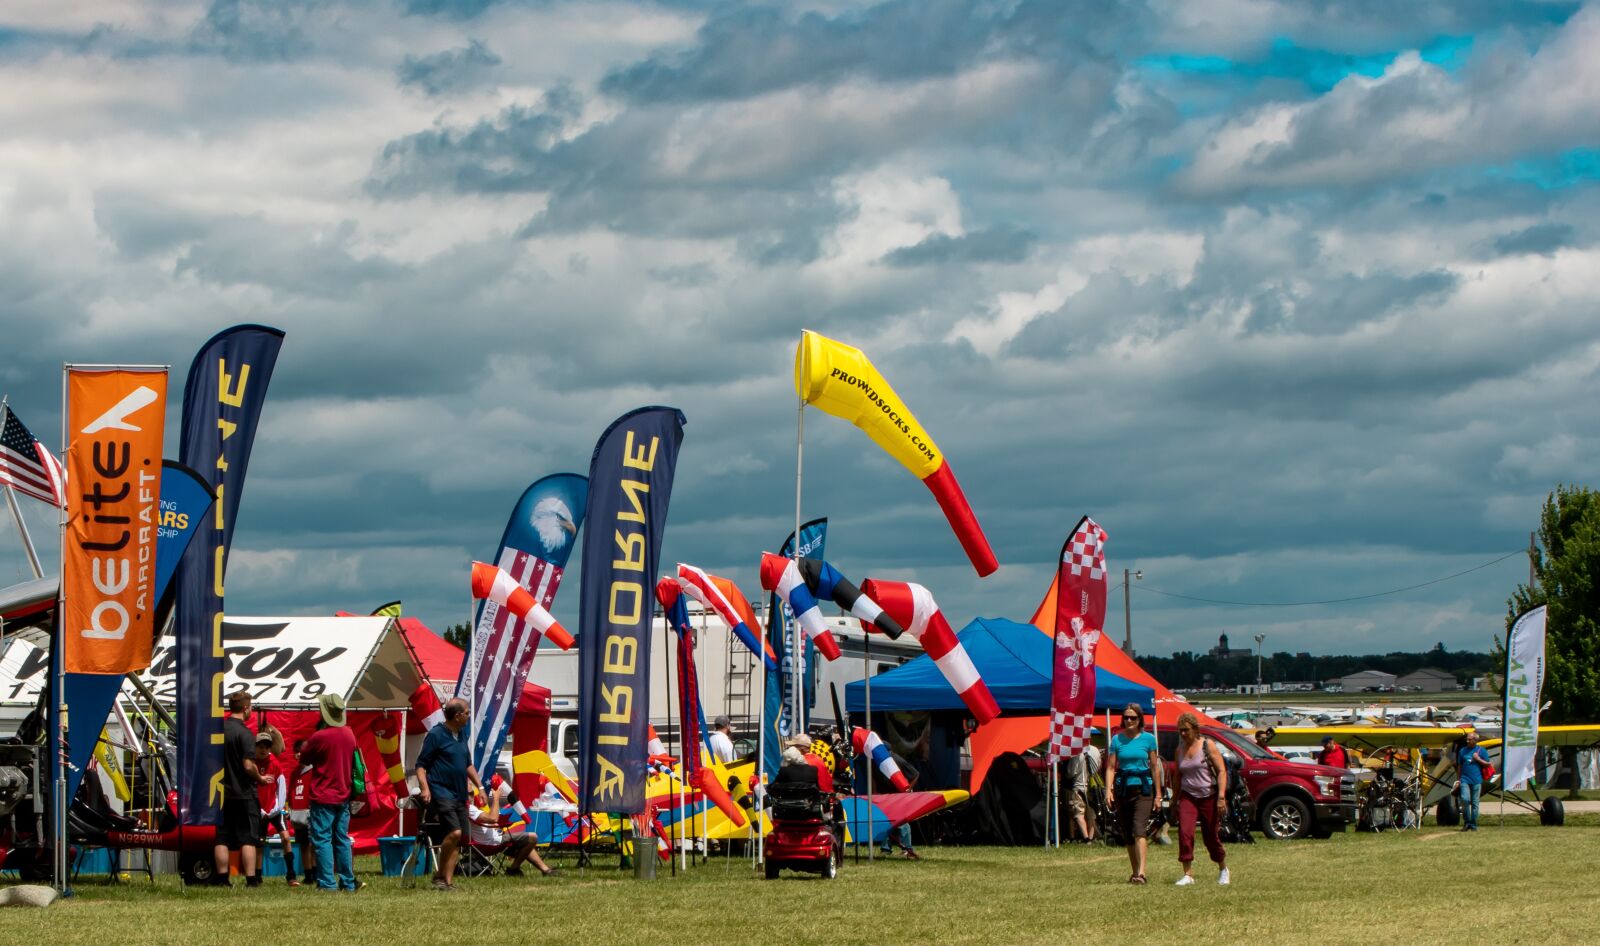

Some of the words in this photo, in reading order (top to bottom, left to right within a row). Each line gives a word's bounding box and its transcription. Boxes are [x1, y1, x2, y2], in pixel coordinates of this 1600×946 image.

[136, 470, 156, 611] AIRCRAFT
[1070, 674, 1078, 699] verner
[1507, 657, 1537, 747] MACFLY
